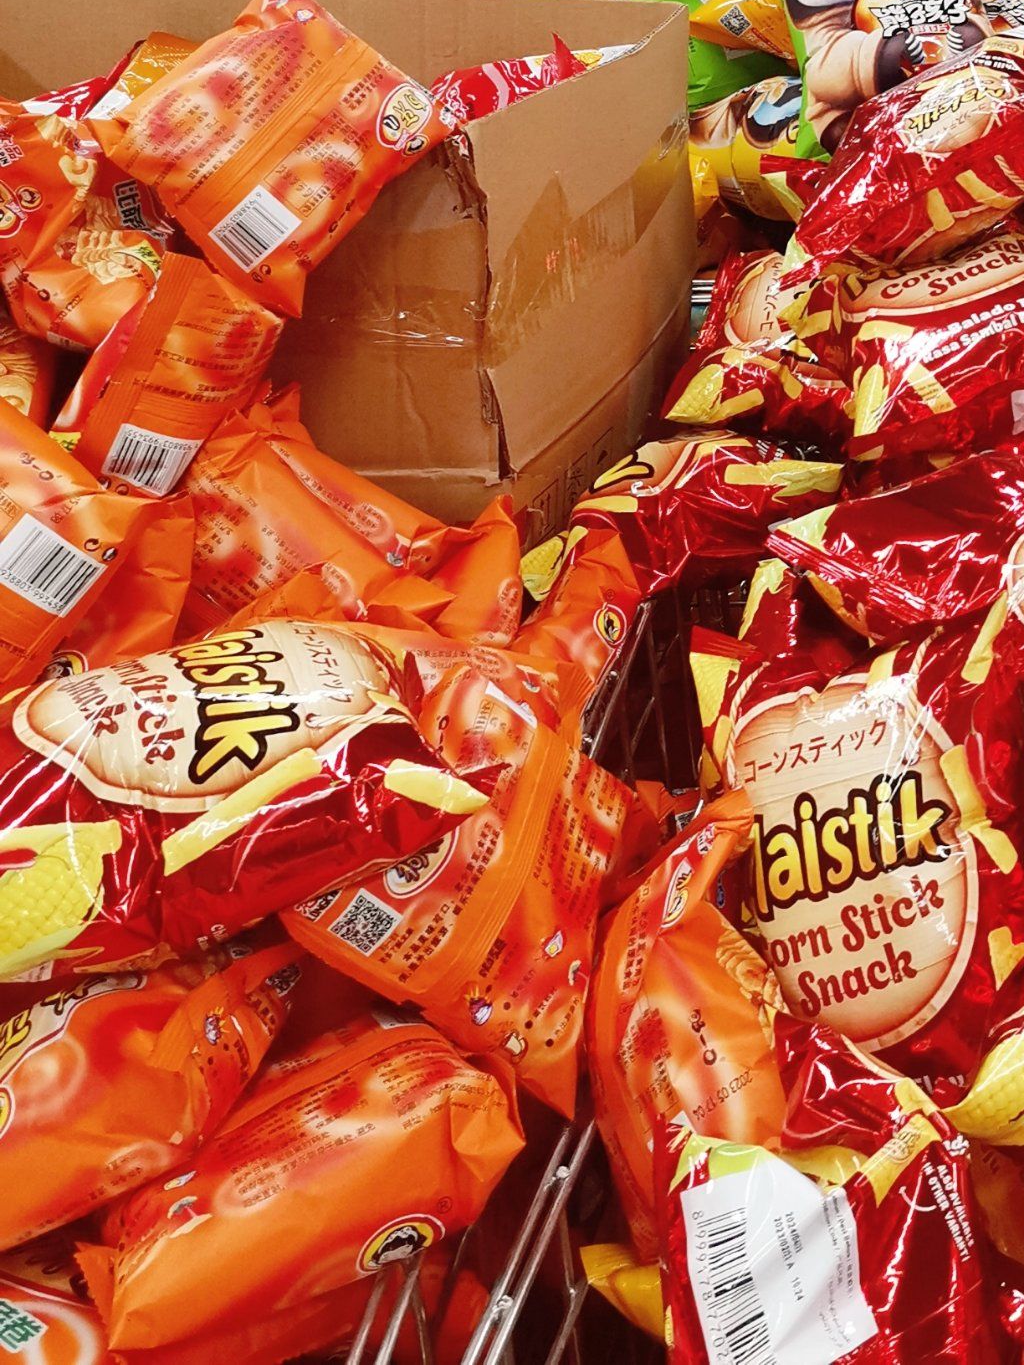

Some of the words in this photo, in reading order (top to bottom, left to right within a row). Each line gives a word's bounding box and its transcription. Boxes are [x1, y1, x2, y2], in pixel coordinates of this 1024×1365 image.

[928, 252, 1023, 297] Snack
[744, 718, 889, 784] コーンスティック
[764, 924, 832, 969] orn
[840, 874, 946, 952] Stick
[797, 940, 917, 1018] Snack
[928, 1175, 950, 1212] OTHER
